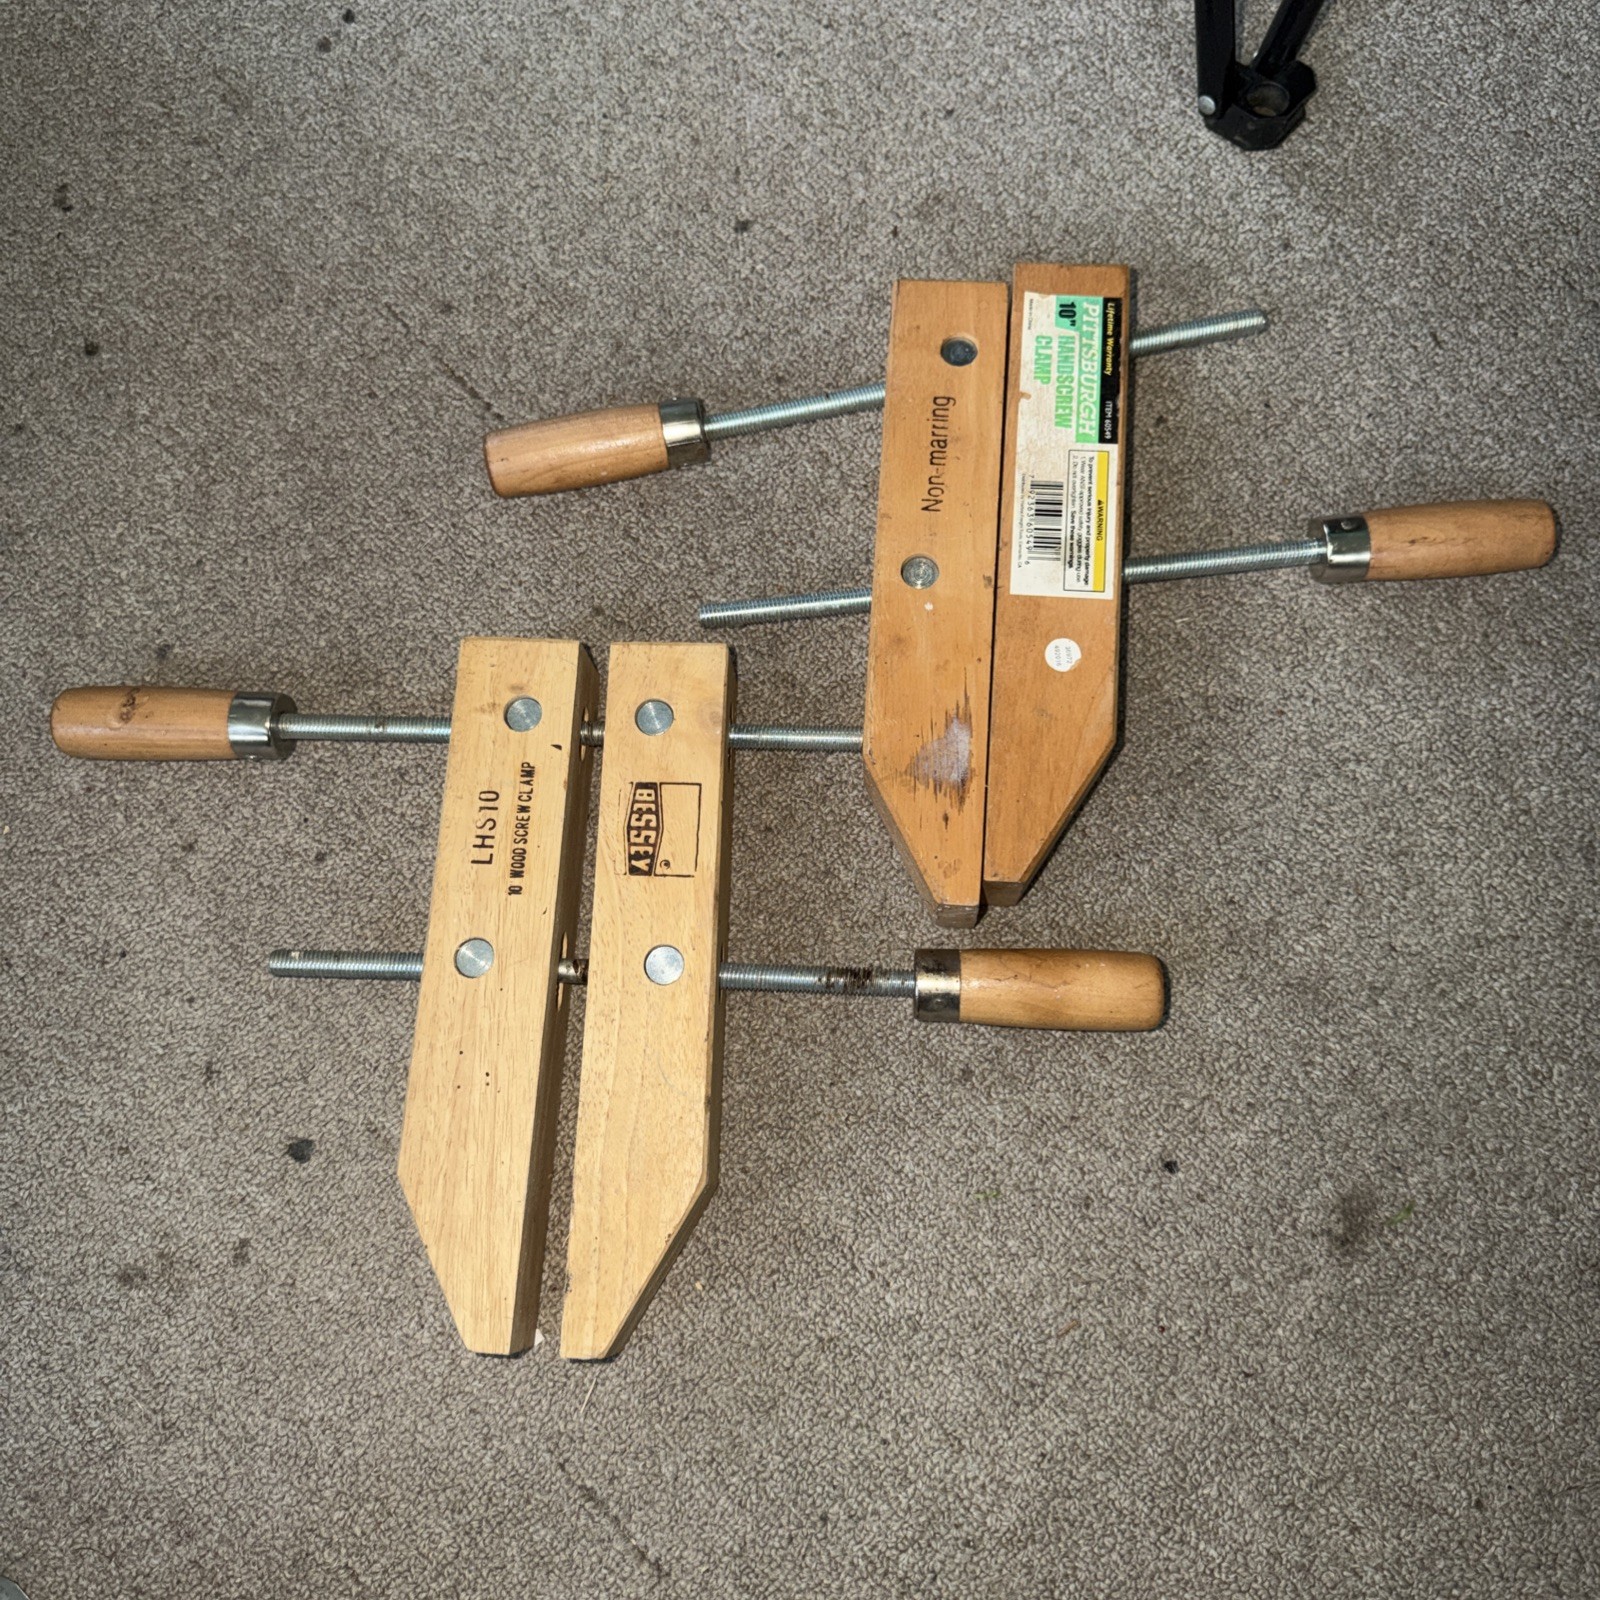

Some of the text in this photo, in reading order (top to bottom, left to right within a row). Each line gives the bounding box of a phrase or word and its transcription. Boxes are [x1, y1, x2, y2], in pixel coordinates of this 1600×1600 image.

[1034, 335, 1053, 385] CLAMP
[1054, 301, 1077, 429] 10" HANDSCREW
[1079, 303, 1100, 436] PITTSBURGH
[1104, 303, 1115, 375] Lifetime Warranty
[1105, 401, 1113, 418] ITEM
[921, 395, 956, 512] Non-marring
[1026, 522, 1034, 550] 60549
[1027, 490, 1035, 517] 92363
[1096, 506, 1104, 541] WARNING
[471, 790, 500, 865] LHS10
[508, 761, 536, 896] 10 WOOD SCREW CLAMP
[629, 789, 657, 872] BESSEY
